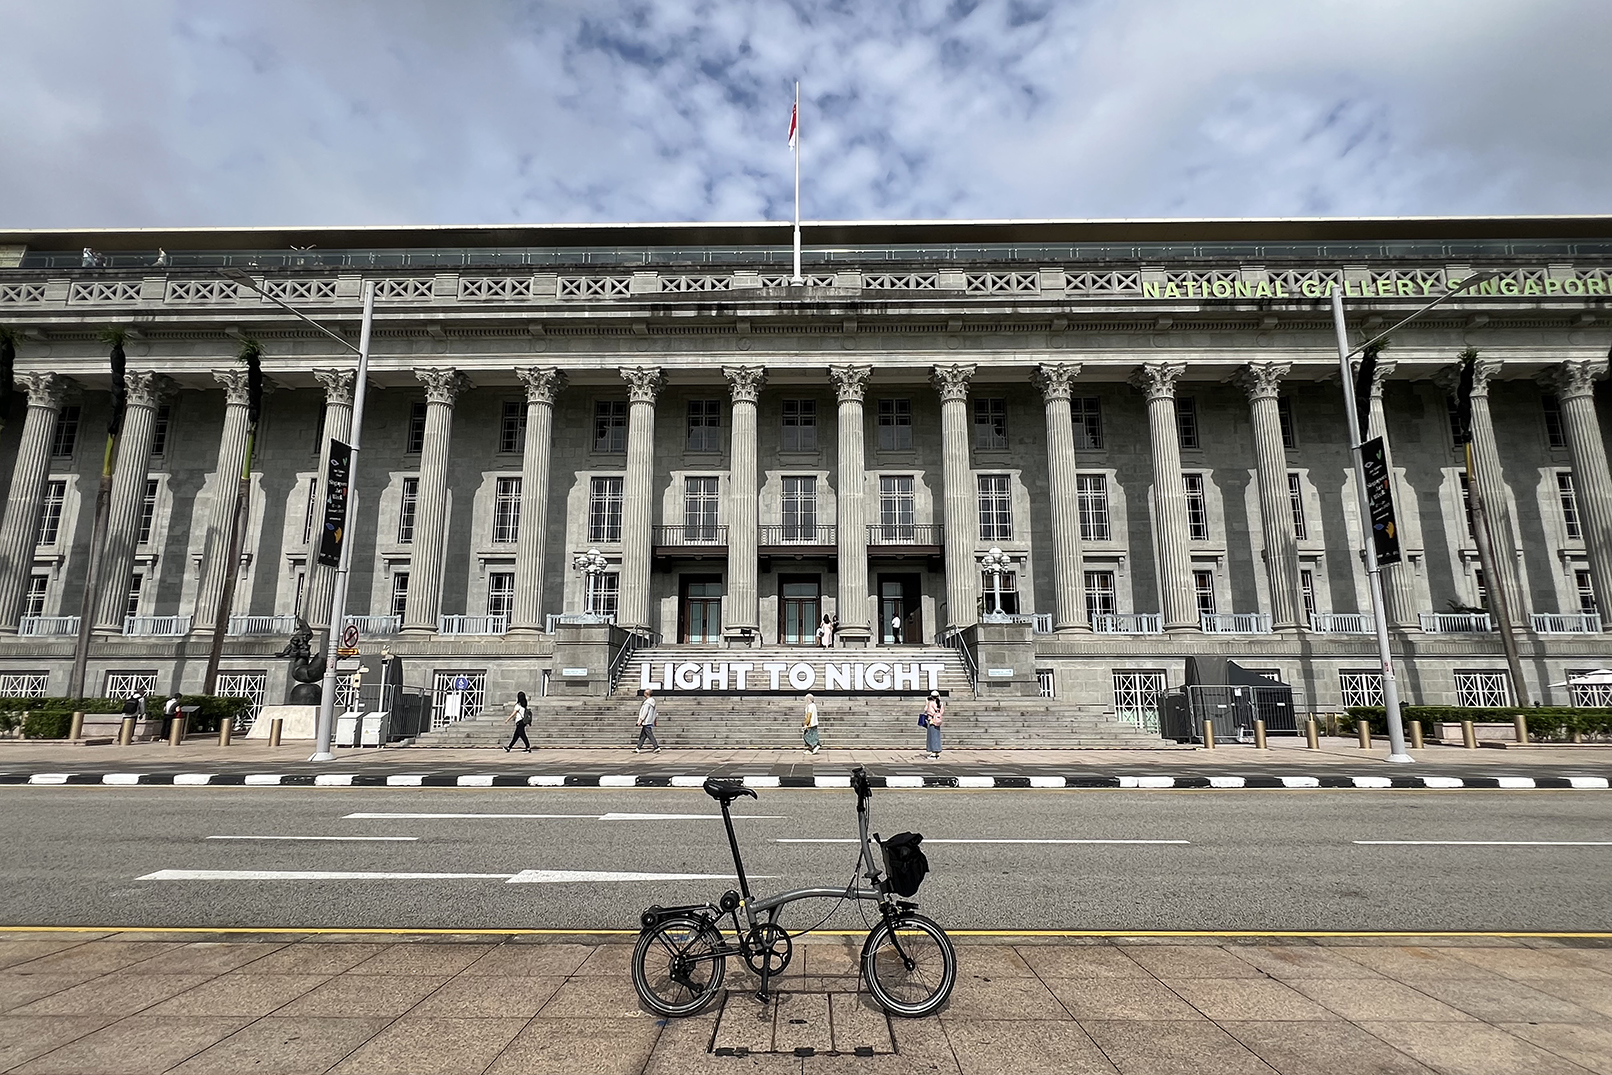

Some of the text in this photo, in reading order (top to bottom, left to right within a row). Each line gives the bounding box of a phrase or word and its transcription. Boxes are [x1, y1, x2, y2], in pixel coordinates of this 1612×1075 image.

[1142, 280, 1288, 297] NATIONAL
[1301, 280, 1433, 297] GALLERY
[641, 663, 945, 690] LIGHT TO NIGHT
